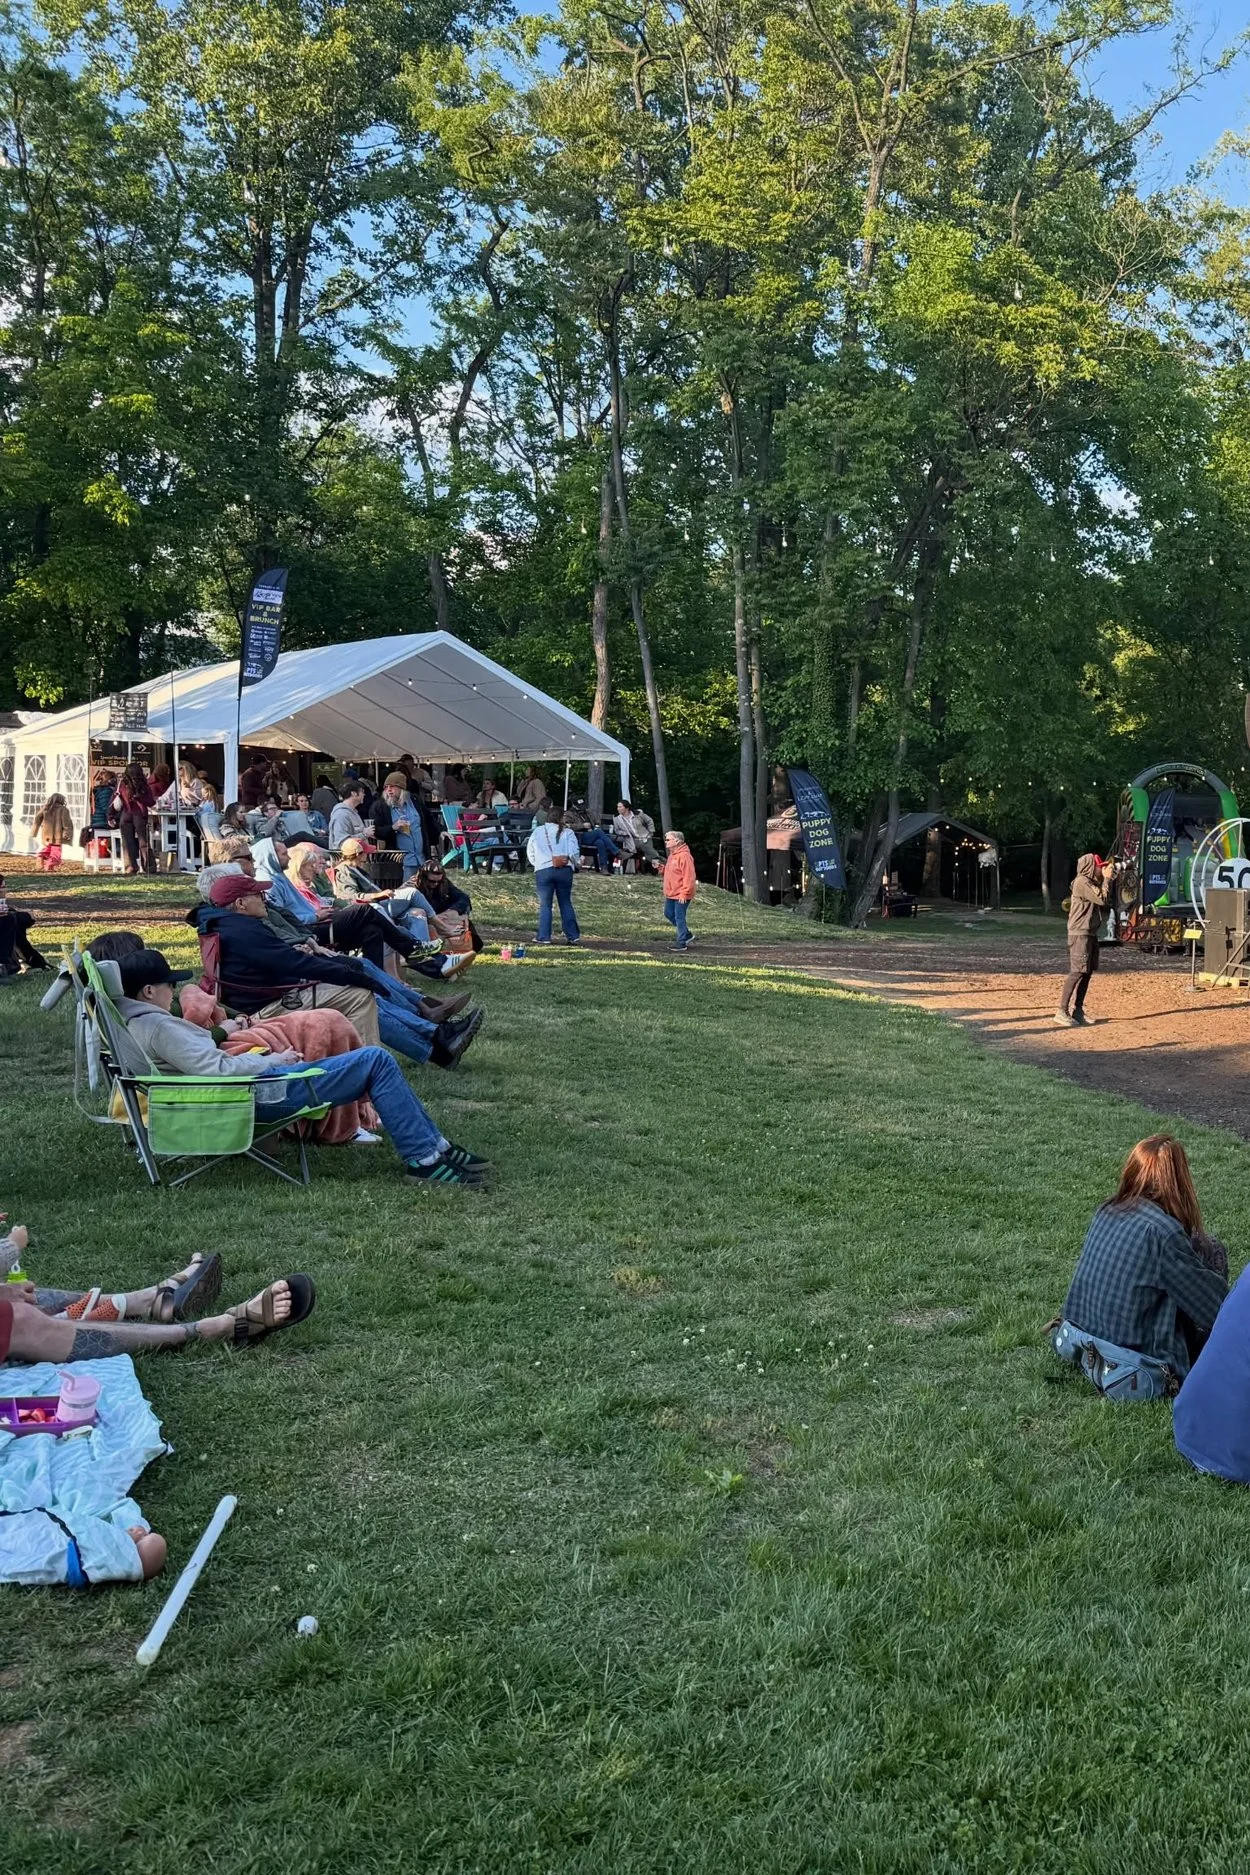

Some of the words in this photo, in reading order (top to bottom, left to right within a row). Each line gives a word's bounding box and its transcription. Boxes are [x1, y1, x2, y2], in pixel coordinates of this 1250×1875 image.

[250, 615, 279, 625] BRUNCH
[802, 817, 831, 829] PUPPY
[809, 828, 829, 838] DOG
[809, 838, 833, 848] ZONE
